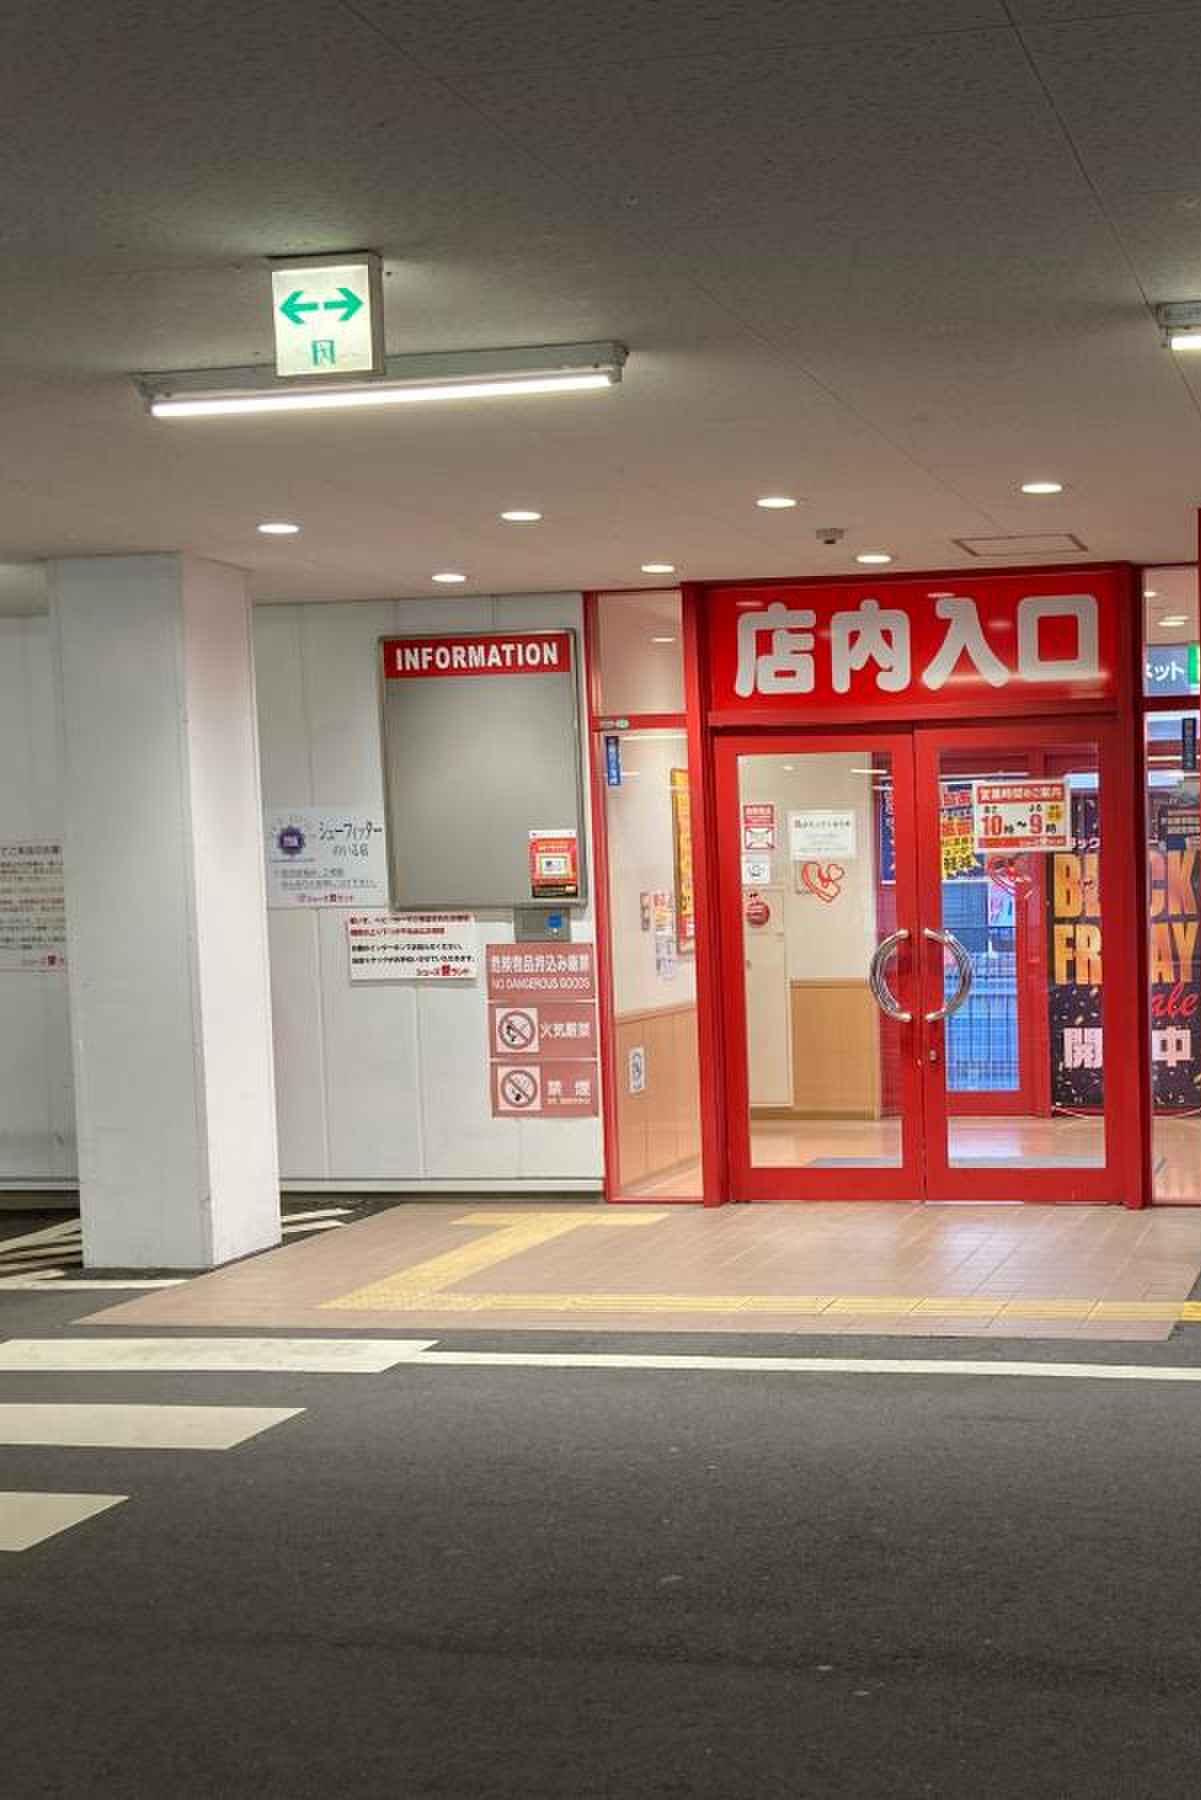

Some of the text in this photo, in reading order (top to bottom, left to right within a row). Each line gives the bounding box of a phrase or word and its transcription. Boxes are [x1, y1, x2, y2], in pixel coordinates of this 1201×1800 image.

[396, 642, 558, 671] INFORMATION
[736, 594, 1099, 698] 店内入口
[1053, 853, 1197, 917] BLCK
[1054, 921, 1199, 985] FRAY
[1151, 981, 1198, 1017] ale
